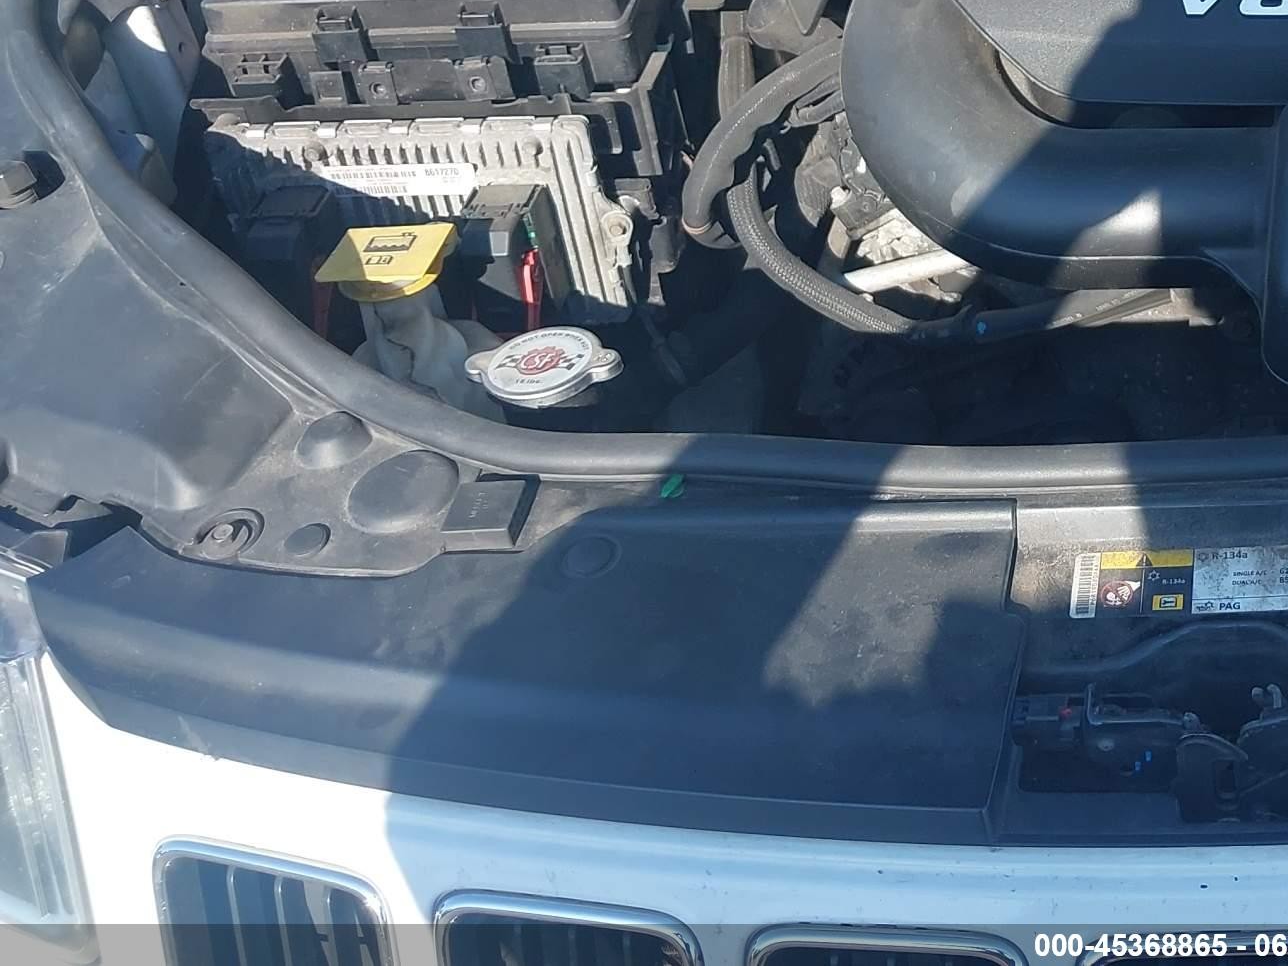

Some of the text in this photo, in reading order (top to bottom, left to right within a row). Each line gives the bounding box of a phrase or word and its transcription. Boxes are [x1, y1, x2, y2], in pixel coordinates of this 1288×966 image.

[521, 352, 556, 371] CSF
[1211, 550, 1248, 561] R-134a
[1218, 601, 1241, 611] PAG
